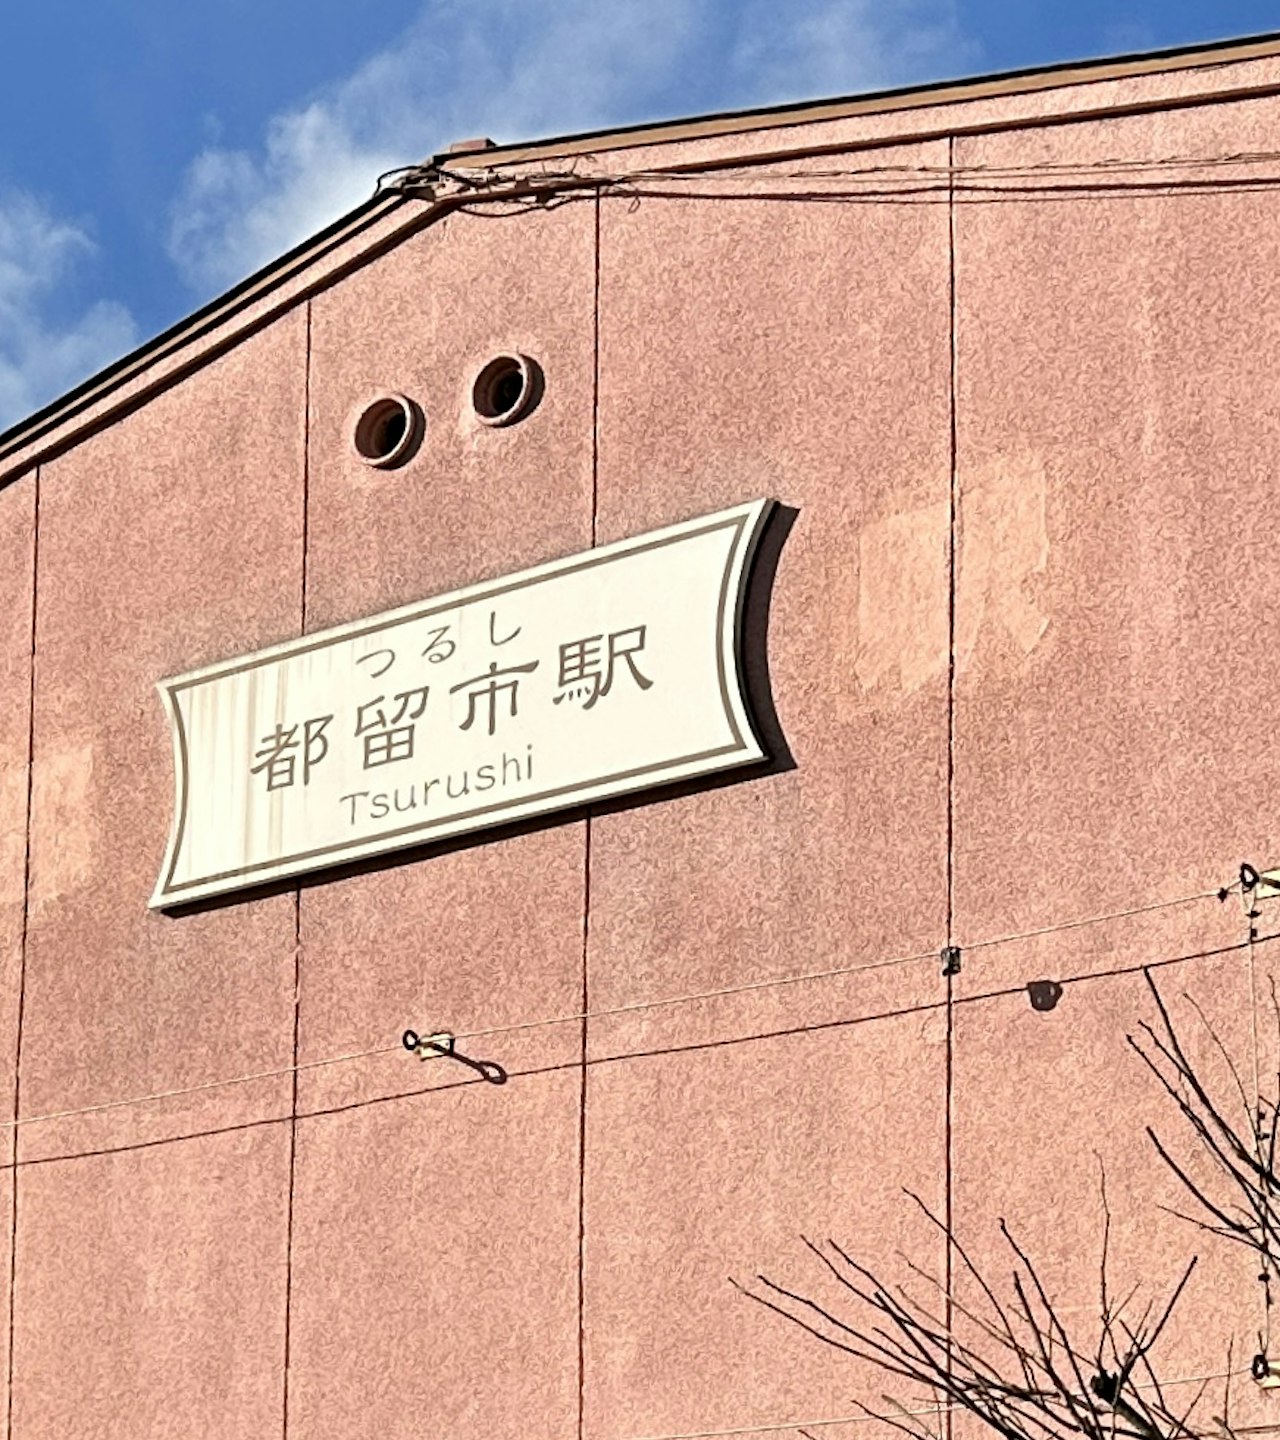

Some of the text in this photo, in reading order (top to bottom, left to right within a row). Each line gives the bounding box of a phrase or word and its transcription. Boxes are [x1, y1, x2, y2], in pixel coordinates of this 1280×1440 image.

[355, 611, 522, 678] つるし
[250, 624, 654, 792] 都留市駅
[339, 744, 535, 827] Tsurushi
